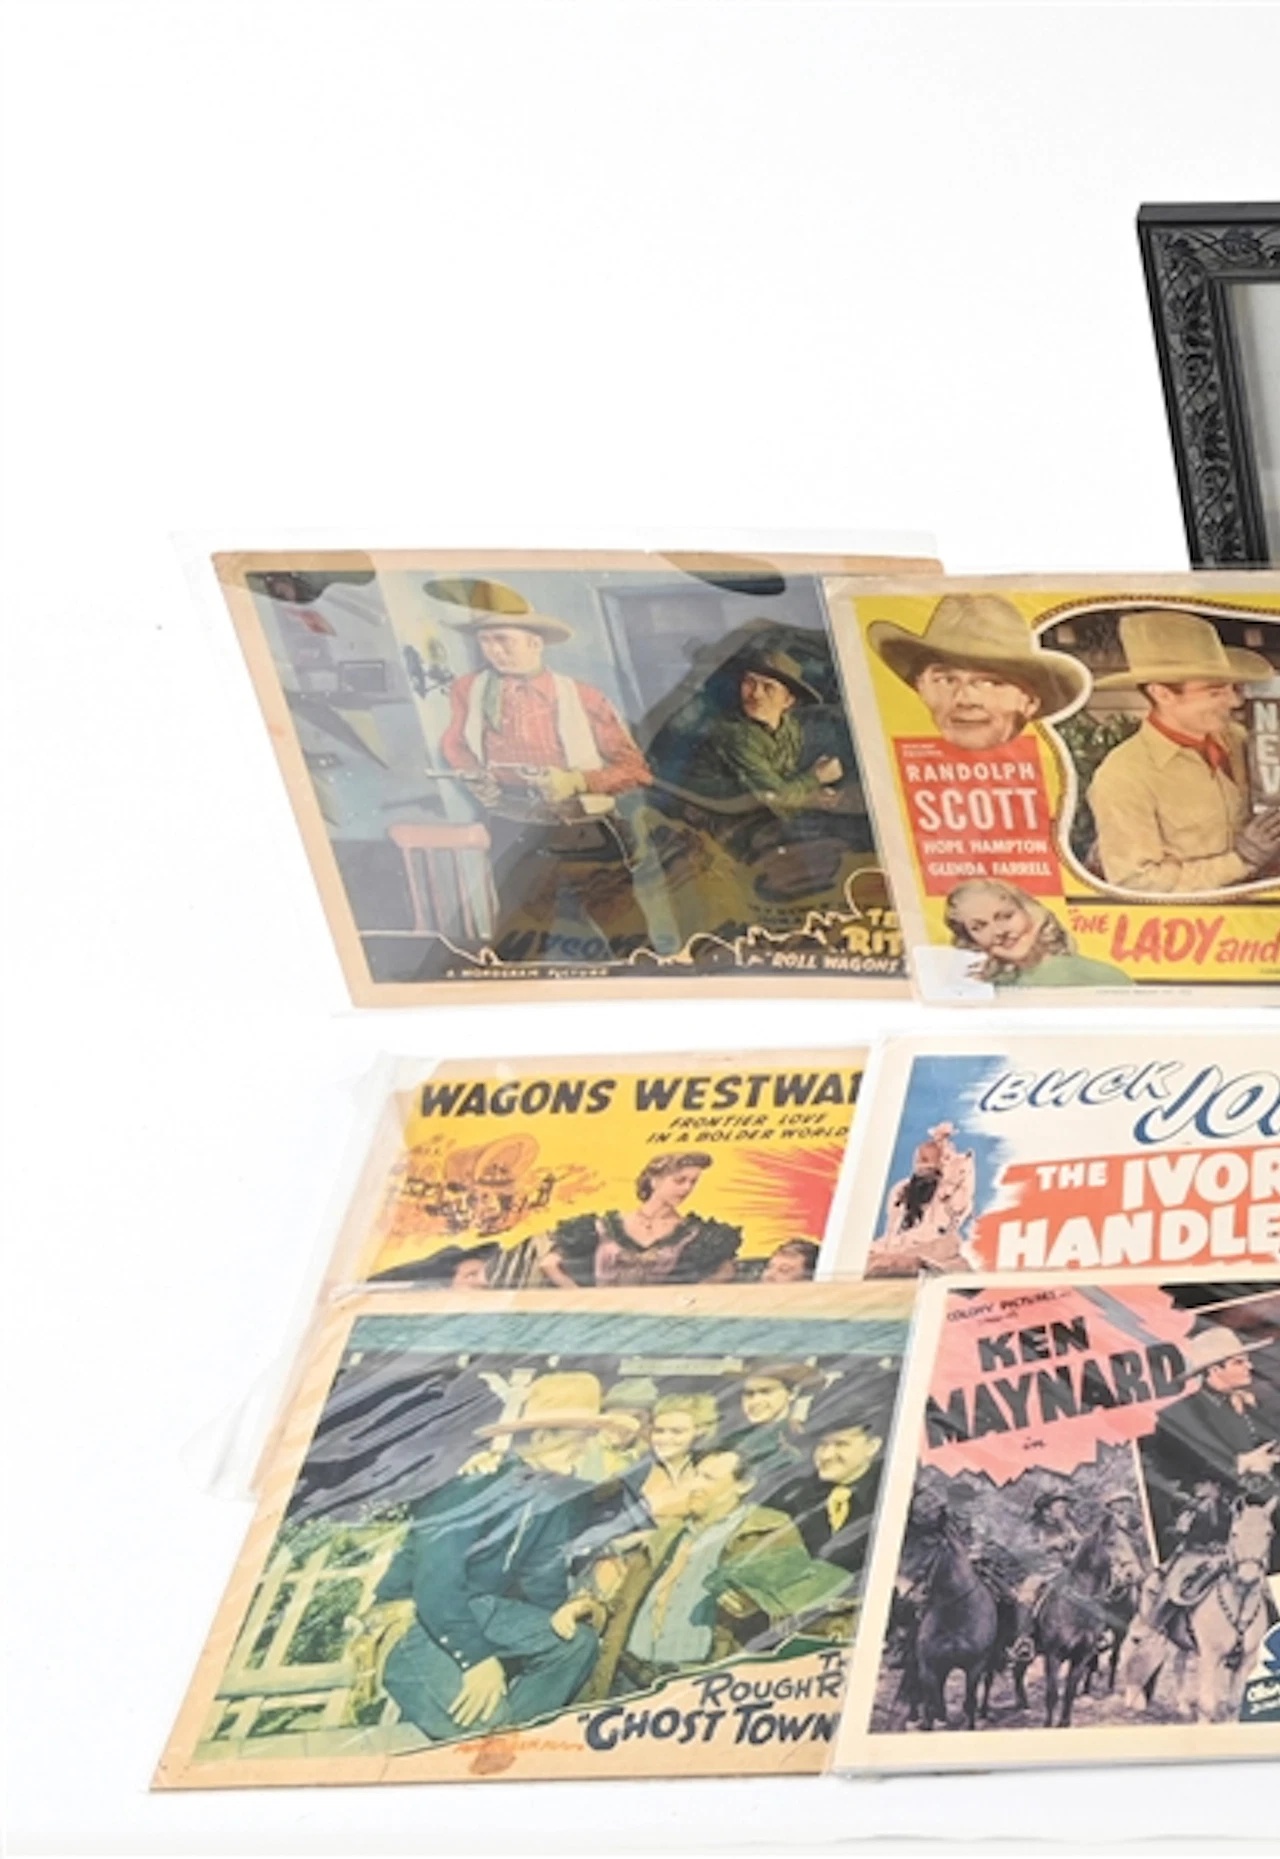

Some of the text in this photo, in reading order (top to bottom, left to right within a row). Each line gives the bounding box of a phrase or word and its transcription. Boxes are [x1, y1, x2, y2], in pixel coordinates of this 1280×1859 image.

[905, 762, 1036, 782] RANDOLPH
[914, 788, 1038, 831] SCOTT
[923, 839, 1048, 855] HOPE HAMPTON
[927, 862, 1052, 876] GLENDA FARRELL
[1111, 914, 1225, 964] LADY
[1216, 928, 1279, 963] and
[823, 955, 898, 973] WAGONS
[420, 1077, 616, 1118] WAGONS
[979, 1060, 1186, 1113] BUCK
[646, 1132, 671, 1144] IN
[676, 1132, 690, 1143] A
[780, 1126, 849, 1139] WORLD
[670, 1113, 827, 1129] FRONTIER LOVE
[1036, 1161, 1108, 1191] THE
[977, 1316, 1090, 1373] KEN
[925, 1343, 1186, 1449] MAYNARD
[693, 1674, 818, 1706] ROUGH
[731, 1701, 841, 1745] TOWN
